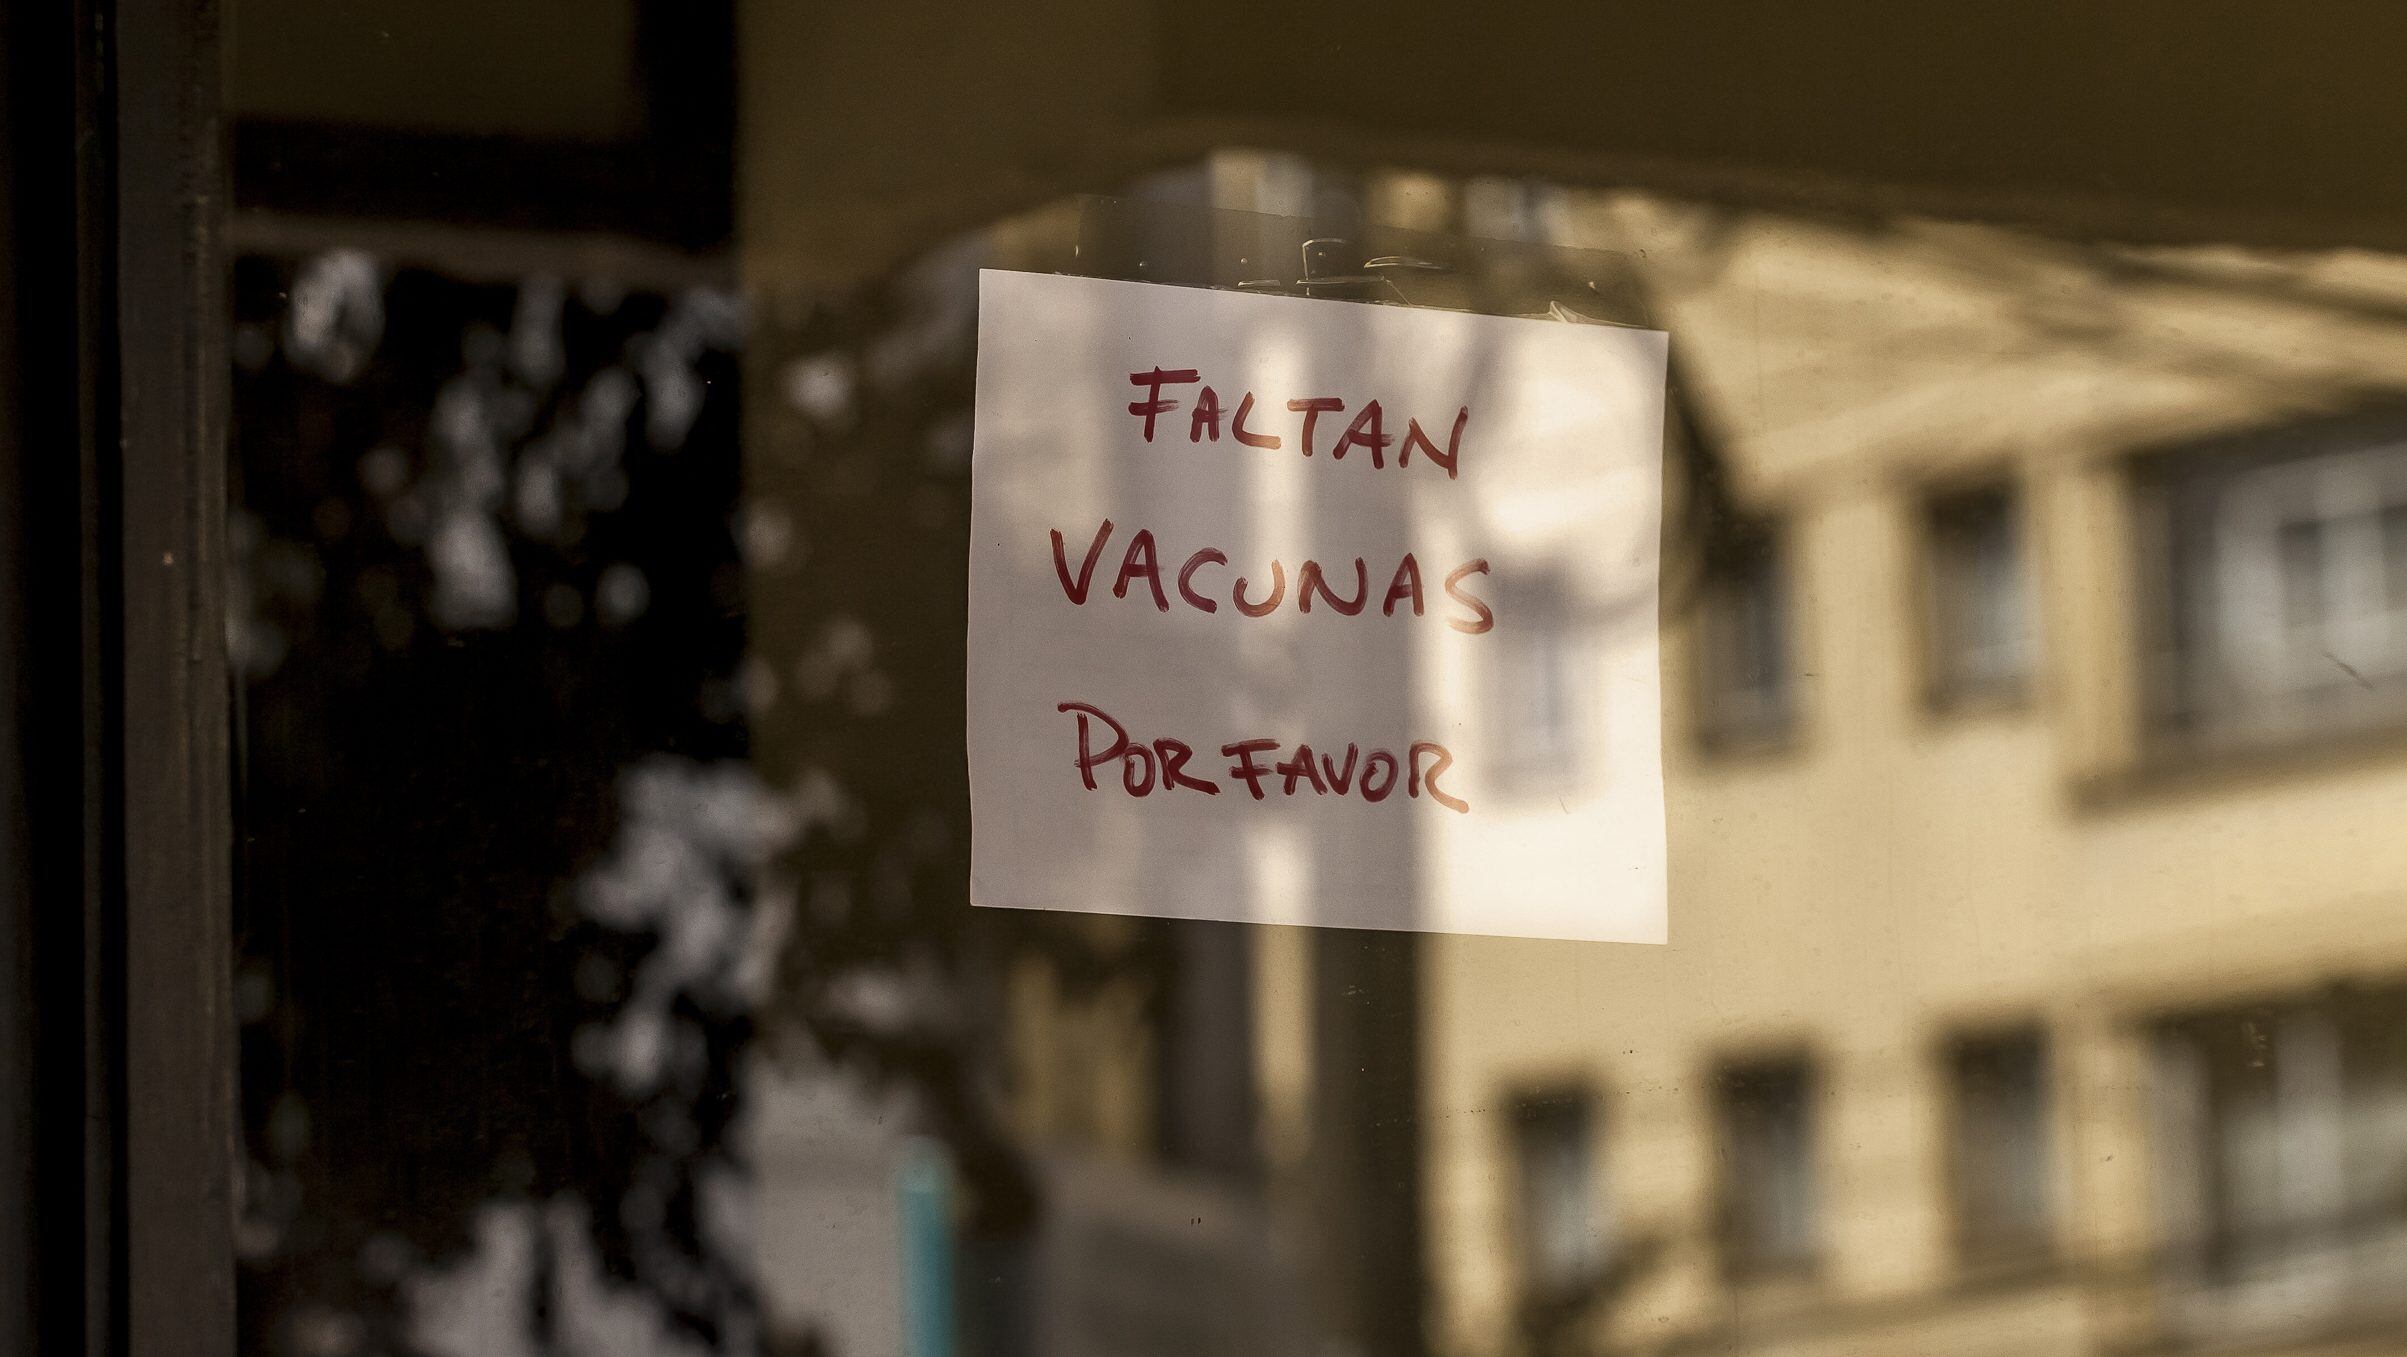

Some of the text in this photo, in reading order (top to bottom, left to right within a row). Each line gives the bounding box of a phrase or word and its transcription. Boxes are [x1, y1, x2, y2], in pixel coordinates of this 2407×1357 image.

[1128, 366, 1469, 480] FALTAN
[1050, 518, 1494, 634] VACUNAS
[1057, 702, 1469, 814] POR FAVOR
